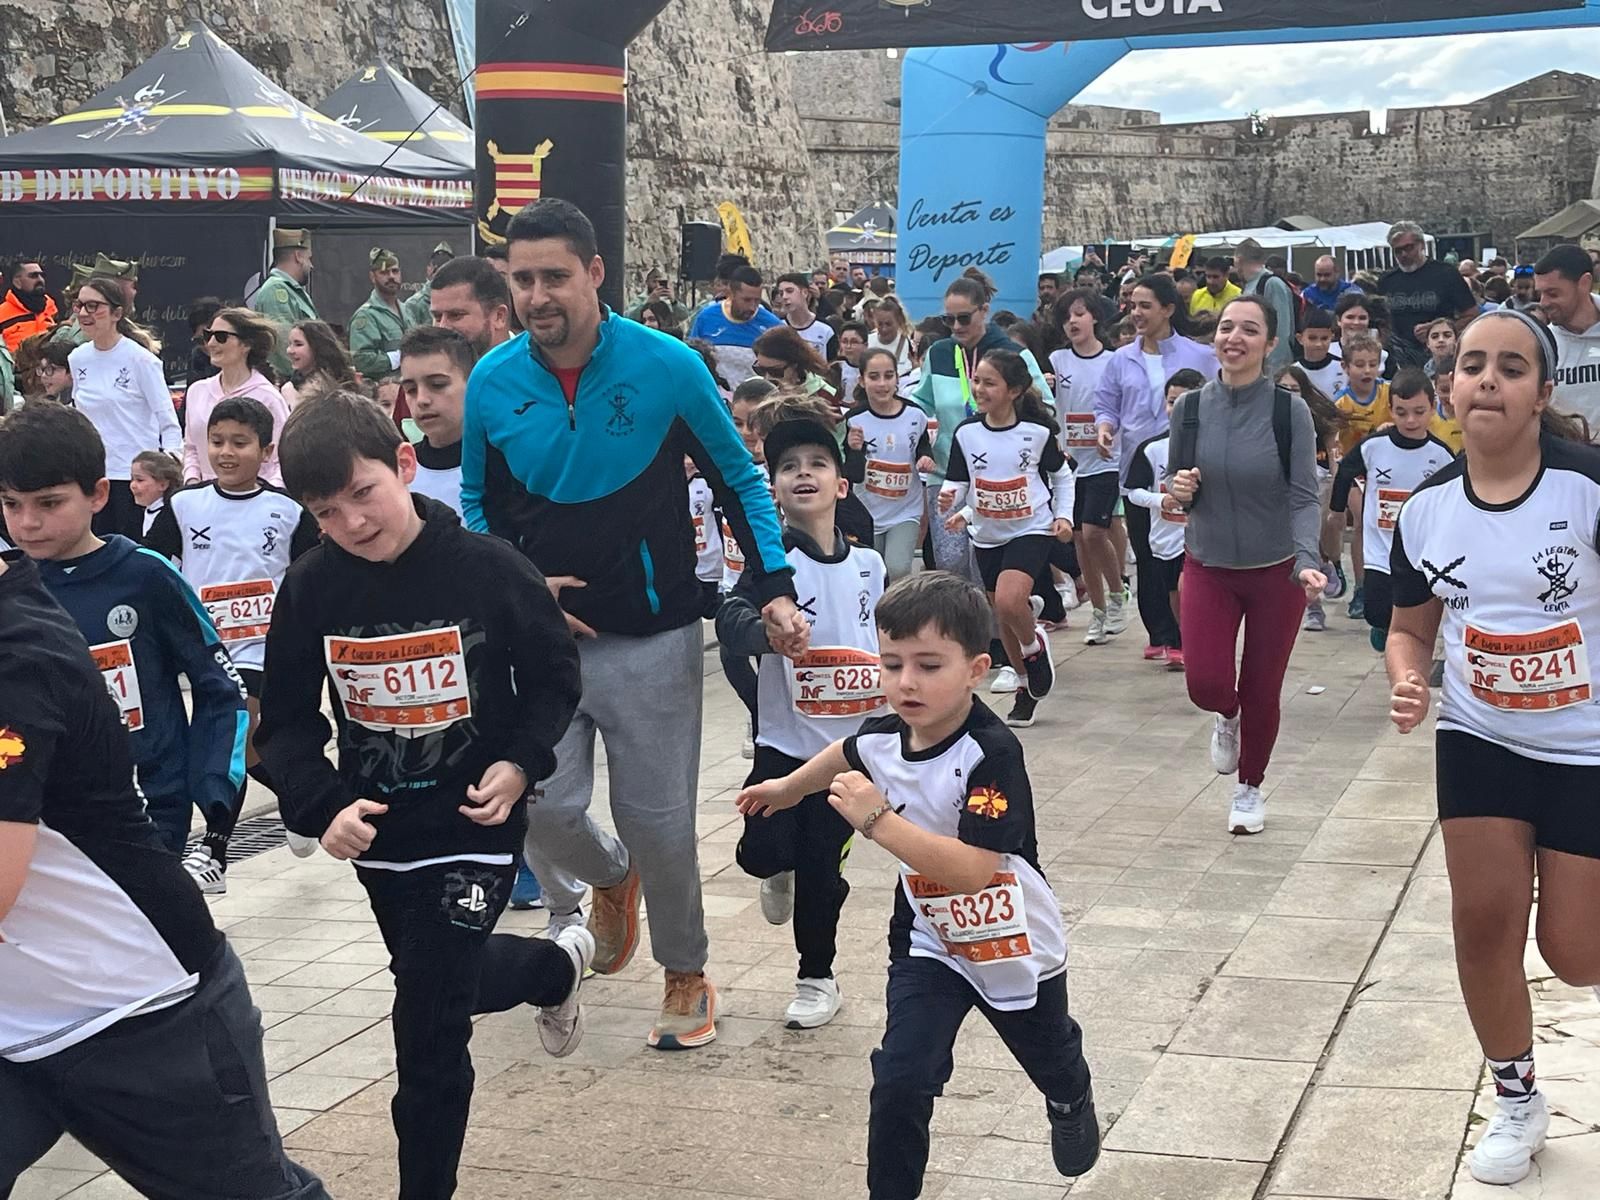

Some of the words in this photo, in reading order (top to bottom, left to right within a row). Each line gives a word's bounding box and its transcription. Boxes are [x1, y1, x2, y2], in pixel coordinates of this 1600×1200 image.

[34, 167, 241, 201] DEPORTIVO
[907, 198, 982, 231] Ceuta
[989, 206, 1016, 222] es
[908, 242, 1016, 283] Deporte
[1553, 363, 1600, 387] PUM
[995, 489, 1027, 506] 6376
[230, 596, 272, 619] 6212
[384, 659, 458, 695] 6112
[833, 668, 881, 690] 6287
[1509, 649, 1577, 683] 6241
[950, 889, 1014, 928] 6323
